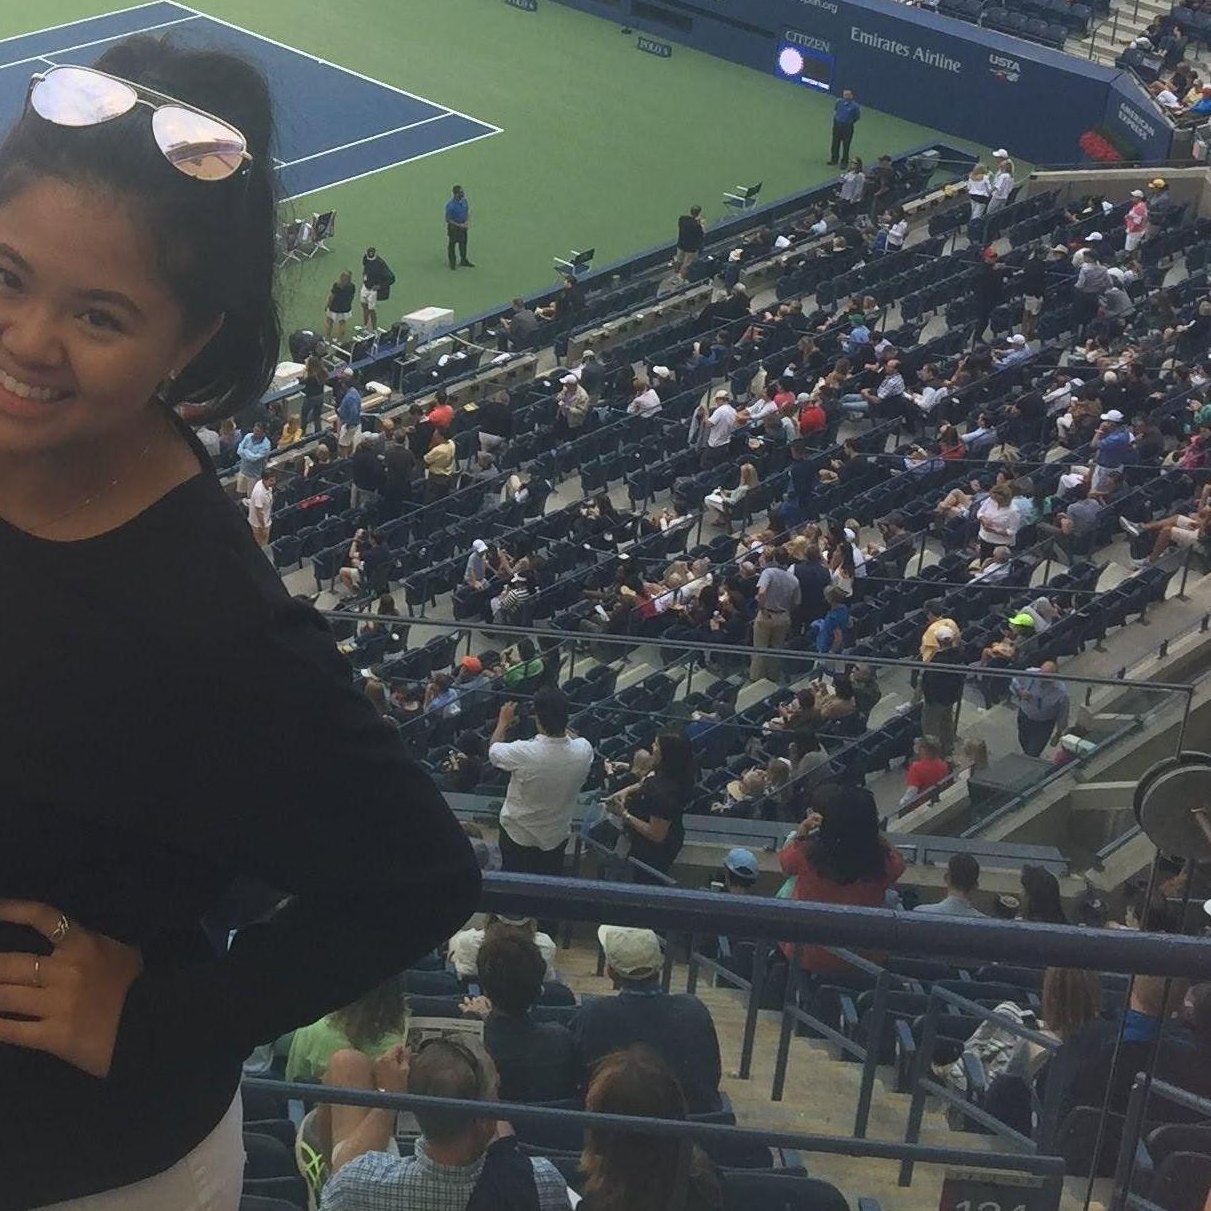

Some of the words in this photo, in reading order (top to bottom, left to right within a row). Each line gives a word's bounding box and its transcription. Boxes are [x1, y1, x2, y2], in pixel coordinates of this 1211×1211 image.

[785, 31, 830, 53] CITIZEN
[850, 27, 910, 57] Emirates
[912, 47, 962, 73] Airline
[988, 54, 1020, 72] USTA
